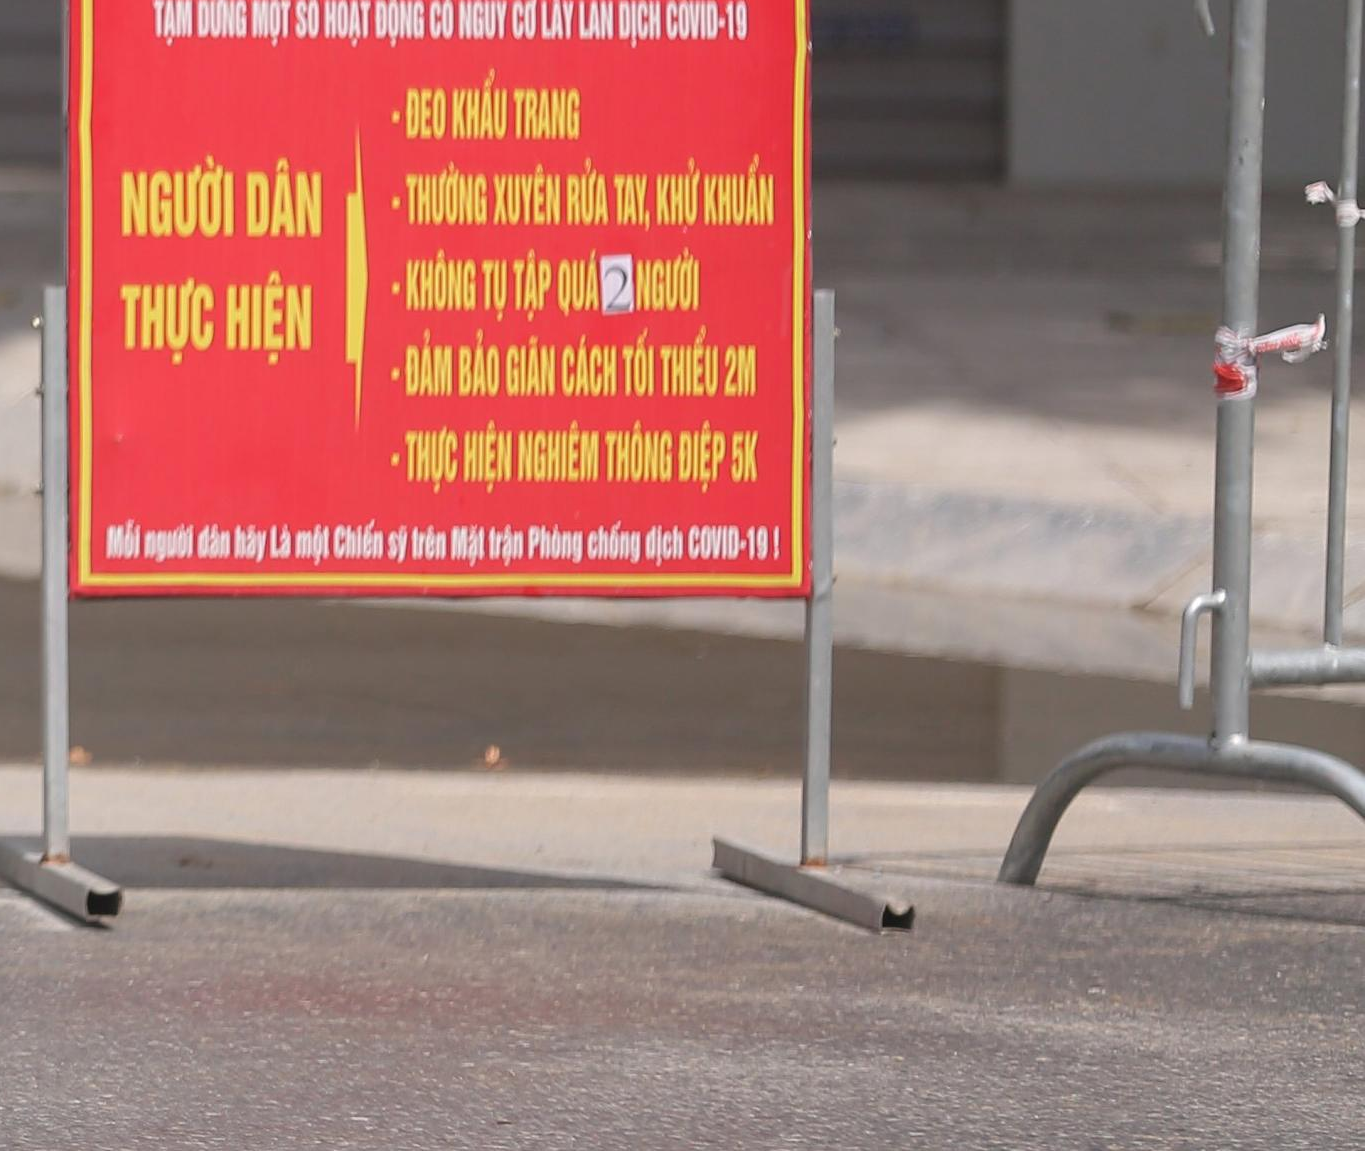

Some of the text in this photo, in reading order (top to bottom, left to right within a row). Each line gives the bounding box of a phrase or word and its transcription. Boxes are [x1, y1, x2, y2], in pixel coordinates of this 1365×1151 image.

[406, 67, 580, 139] ĐEO KHẨU TRANG
[122, 154, 321, 237] NGƯỜI DÂN
[406, 153, 773, 230] THƯỜNG XUYÊN RỬA TAY, KHỬ KHUẨN
[121, 269, 311, 364] THỰC HIỆN
[406, 246, 699, 321] KHÔNG TỤ TẬP QUÁ 2 NGƯỜI
[405, 324, 755, 396] ĐẢM BẢO GIÃN CÁCH TỐI THIỂU 2M
[405, 419, 758, 492] THỰC HIỆN NGHIÊM THÔNG ĐIỆP 5K
[106, 518, 140, 558] Mỗi
[144, 523, 193, 562] người
[198, 522, 230, 558] dân
[234, 523, 266, 562] hãy
[270, 523, 291, 558] Là
[295, 523, 329, 565] một
[333, 518, 383, 558] Chiến
[388, 524, 407, 562] sỹ
[412, 523, 446, 560] trên
[451, 524, 485, 566] Mặt
[489, 523, 523, 566] trận
[528, 523, 583, 563] Phòng
[587, 520, 640, 563] chống
[646, 524, 683, 565] dịch
[688, 524, 768, 559] COVID-19
